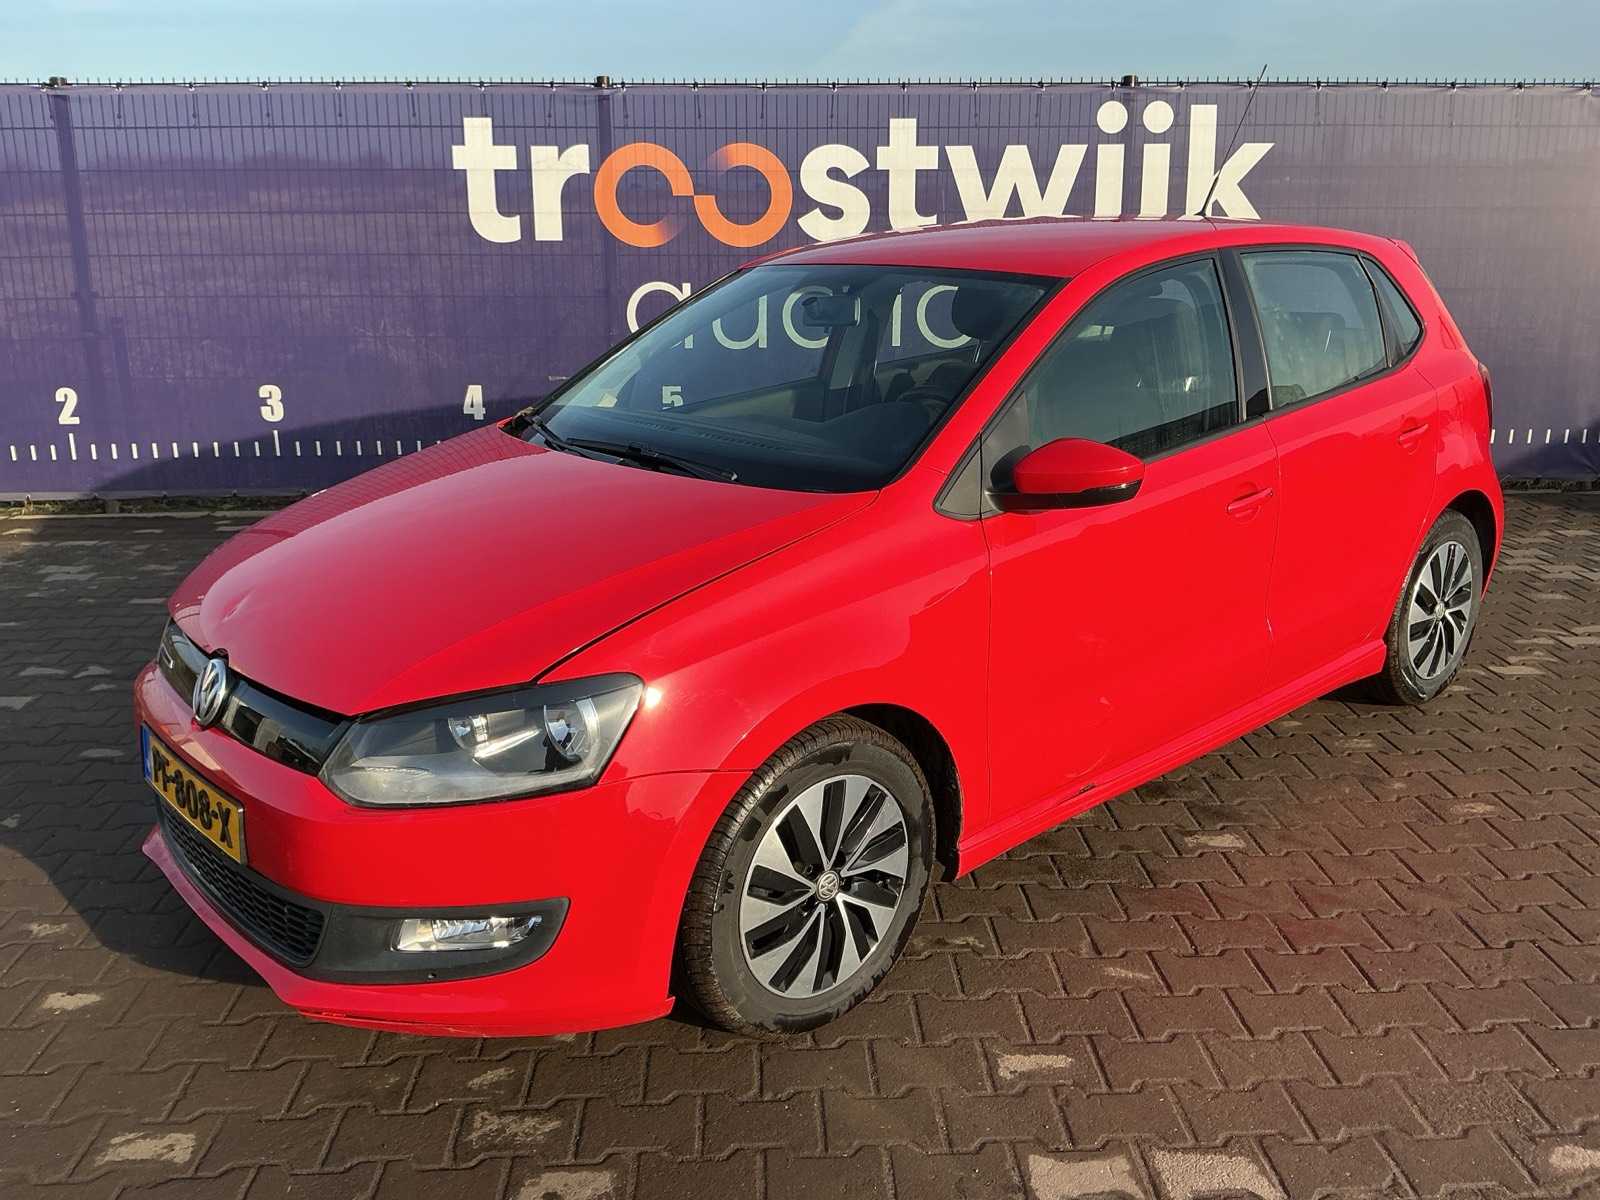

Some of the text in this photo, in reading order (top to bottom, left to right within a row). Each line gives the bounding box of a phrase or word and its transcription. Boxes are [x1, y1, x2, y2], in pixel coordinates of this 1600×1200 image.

[55, 384, 684, 425] 2 3 4 5
